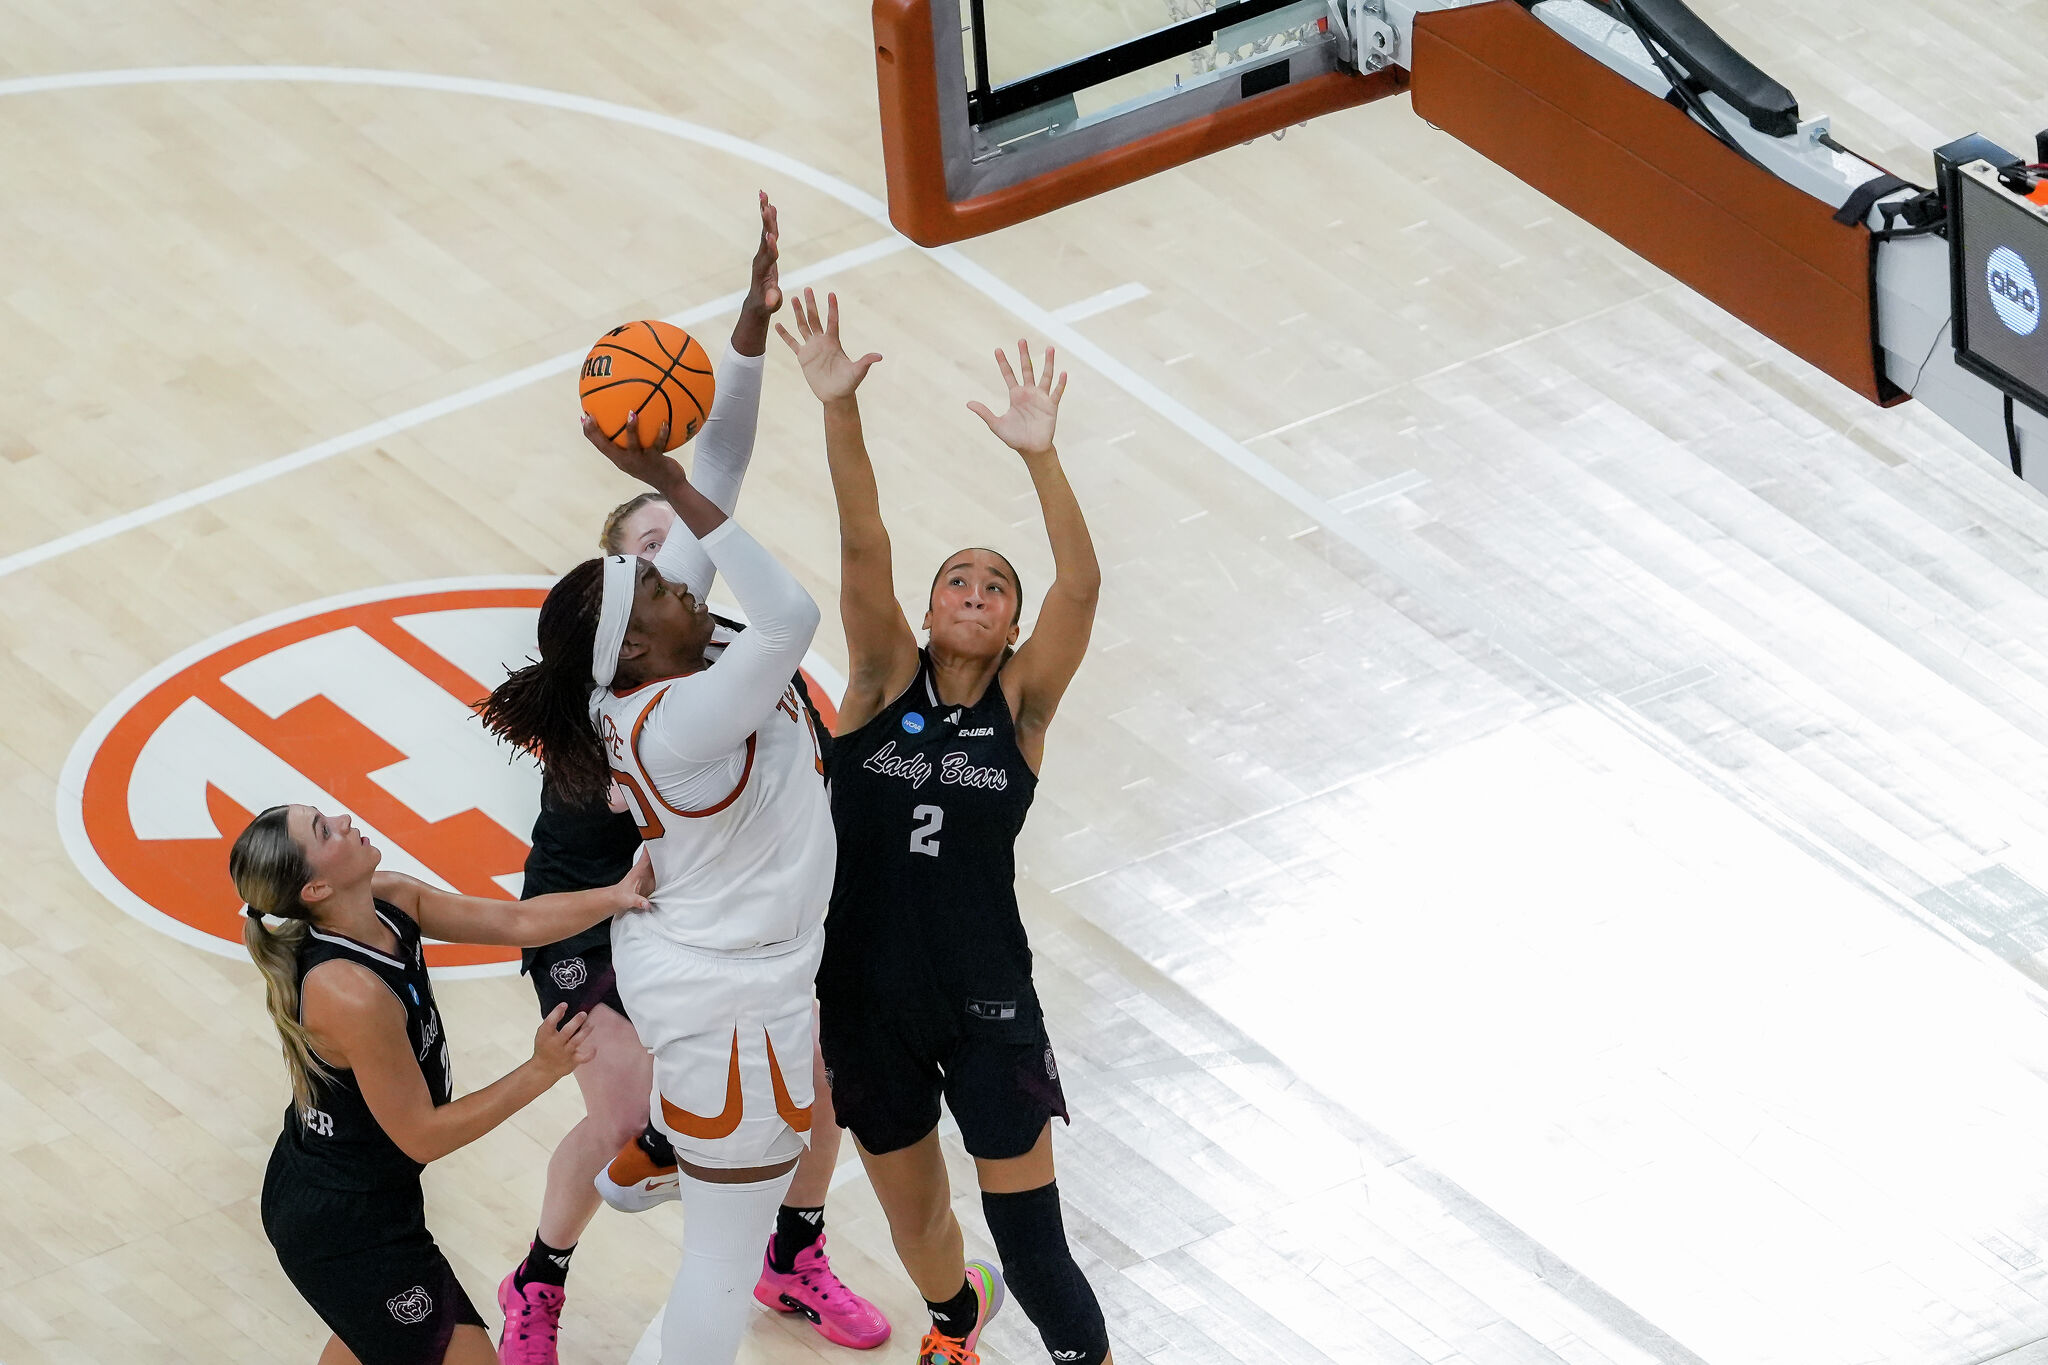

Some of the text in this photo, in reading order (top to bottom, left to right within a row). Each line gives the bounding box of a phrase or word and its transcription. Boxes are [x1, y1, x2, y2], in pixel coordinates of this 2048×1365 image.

[1989, 267, 2035, 313] abc
[863, 740, 932, 789] Lady
[940, 751, 1008, 791] Bears
[909, 803, 944, 858] 2
[303, 1104, 334, 1137] ER
